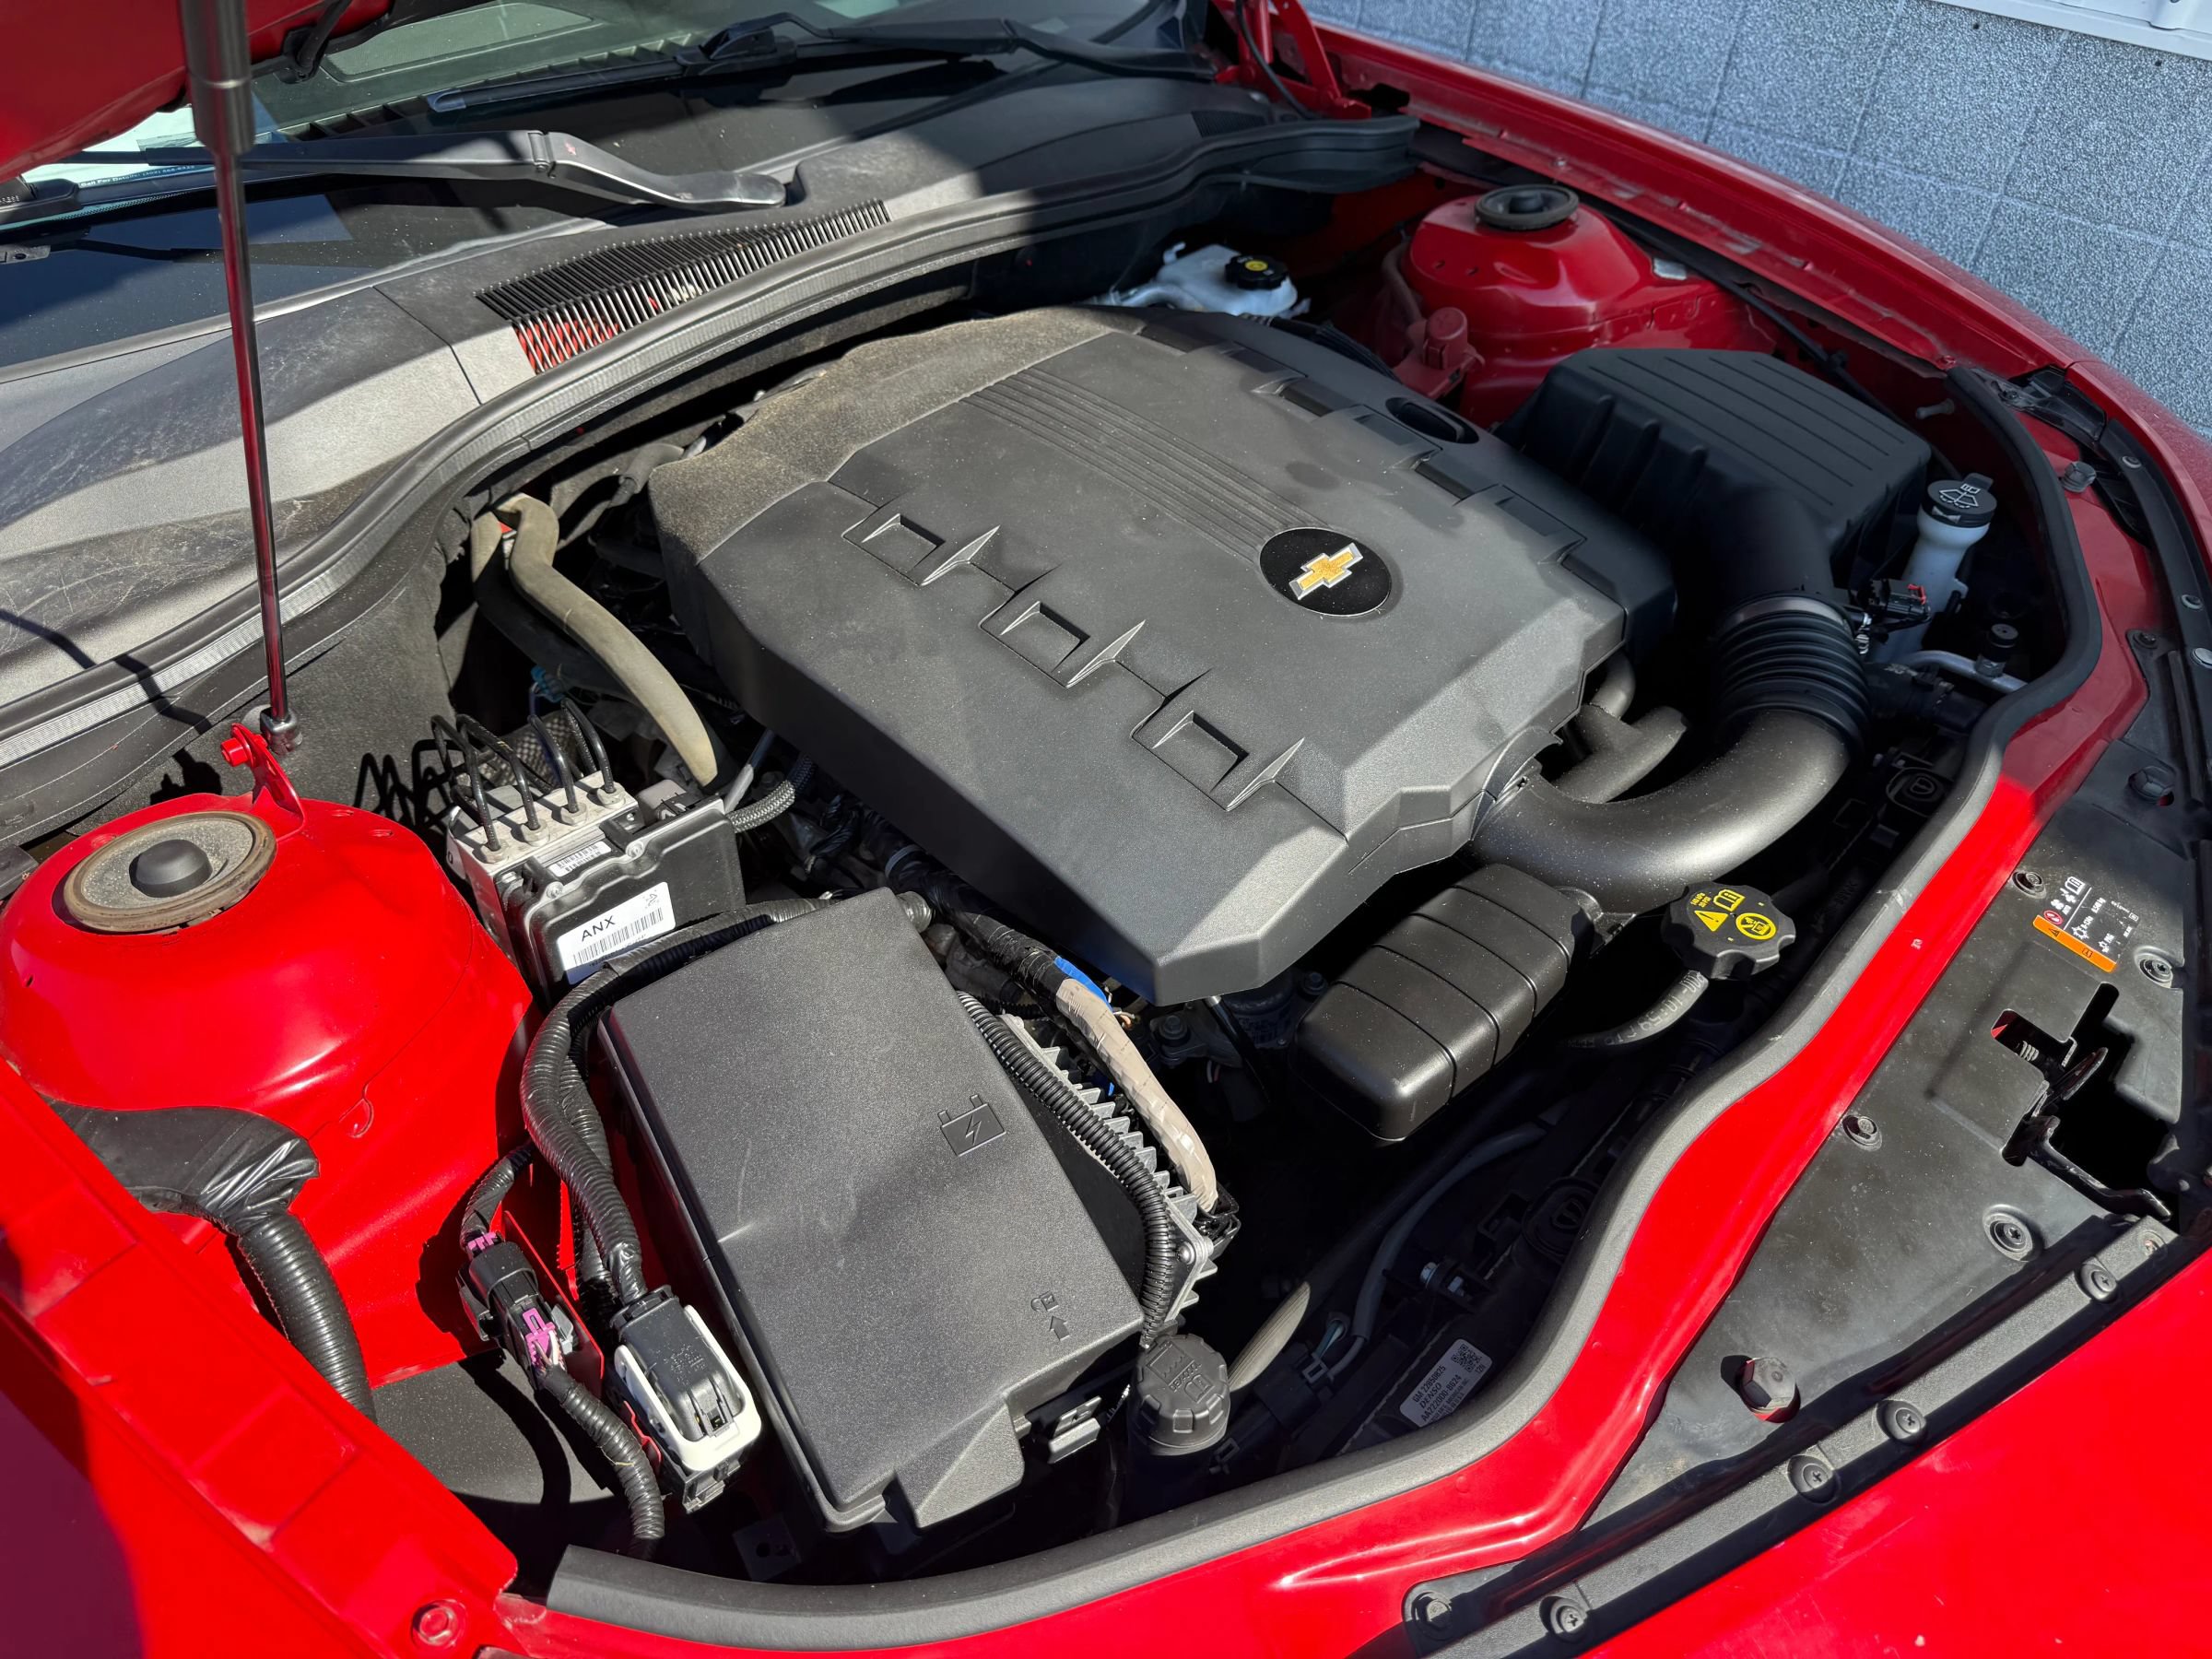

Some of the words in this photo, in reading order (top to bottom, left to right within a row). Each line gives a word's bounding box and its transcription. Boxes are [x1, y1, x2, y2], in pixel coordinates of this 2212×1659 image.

[582, 915, 616, 942] ANX
[1413, 1390, 1424, 1403] GM
[1419, 1382, 1442, 1408] DENSO
